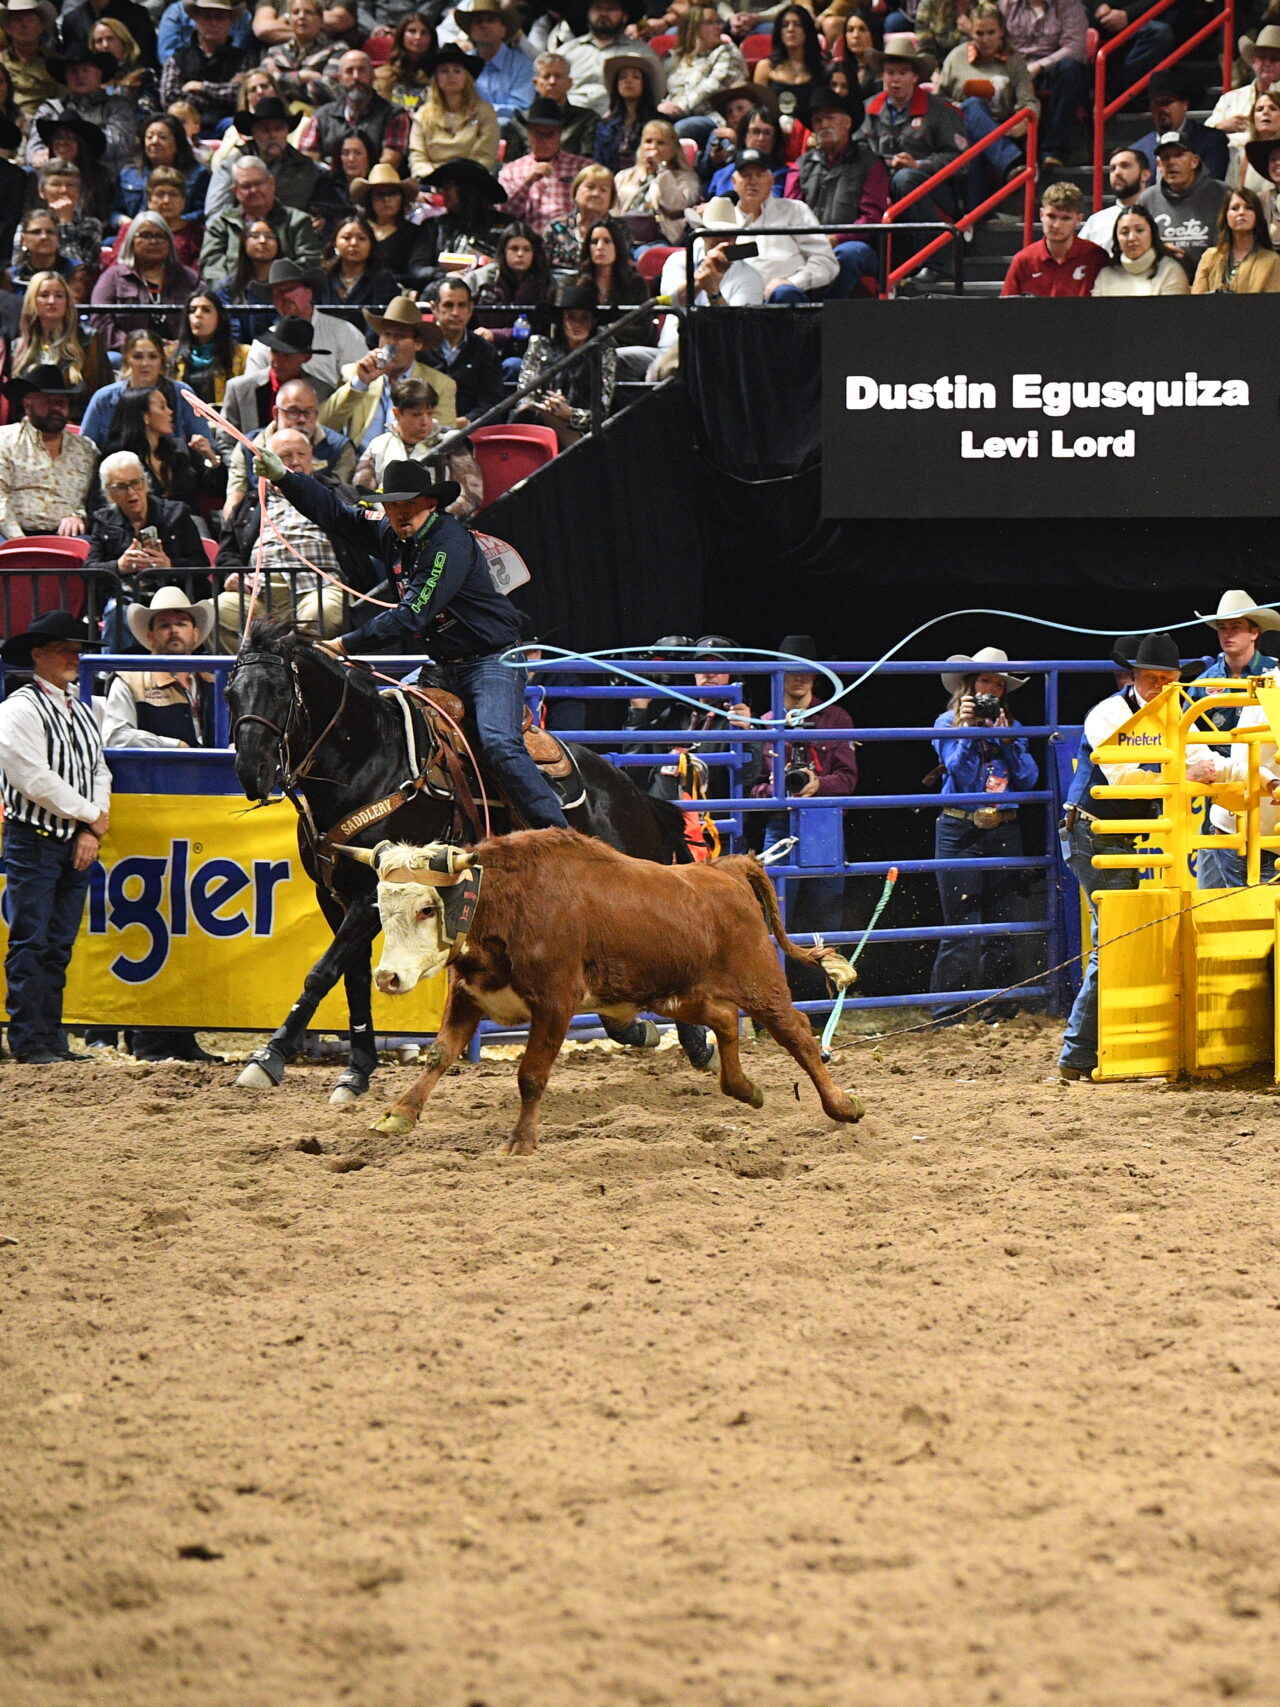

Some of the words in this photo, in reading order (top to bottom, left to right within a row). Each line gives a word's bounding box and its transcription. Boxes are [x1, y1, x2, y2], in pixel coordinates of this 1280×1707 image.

[846, 375, 996, 410] Dustin
[1012, 372, 1250, 416] Egusquiza
[961, 430, 1039, 458] Levi
[1052, 430, 1135, 458] Lord
[411, 551, 447, 614] CINCH
[1118, 732, 1162, 747] Priefert
[340, 799, 393, 836] SADDLERY
[0, 838, 290, 986] ngler
